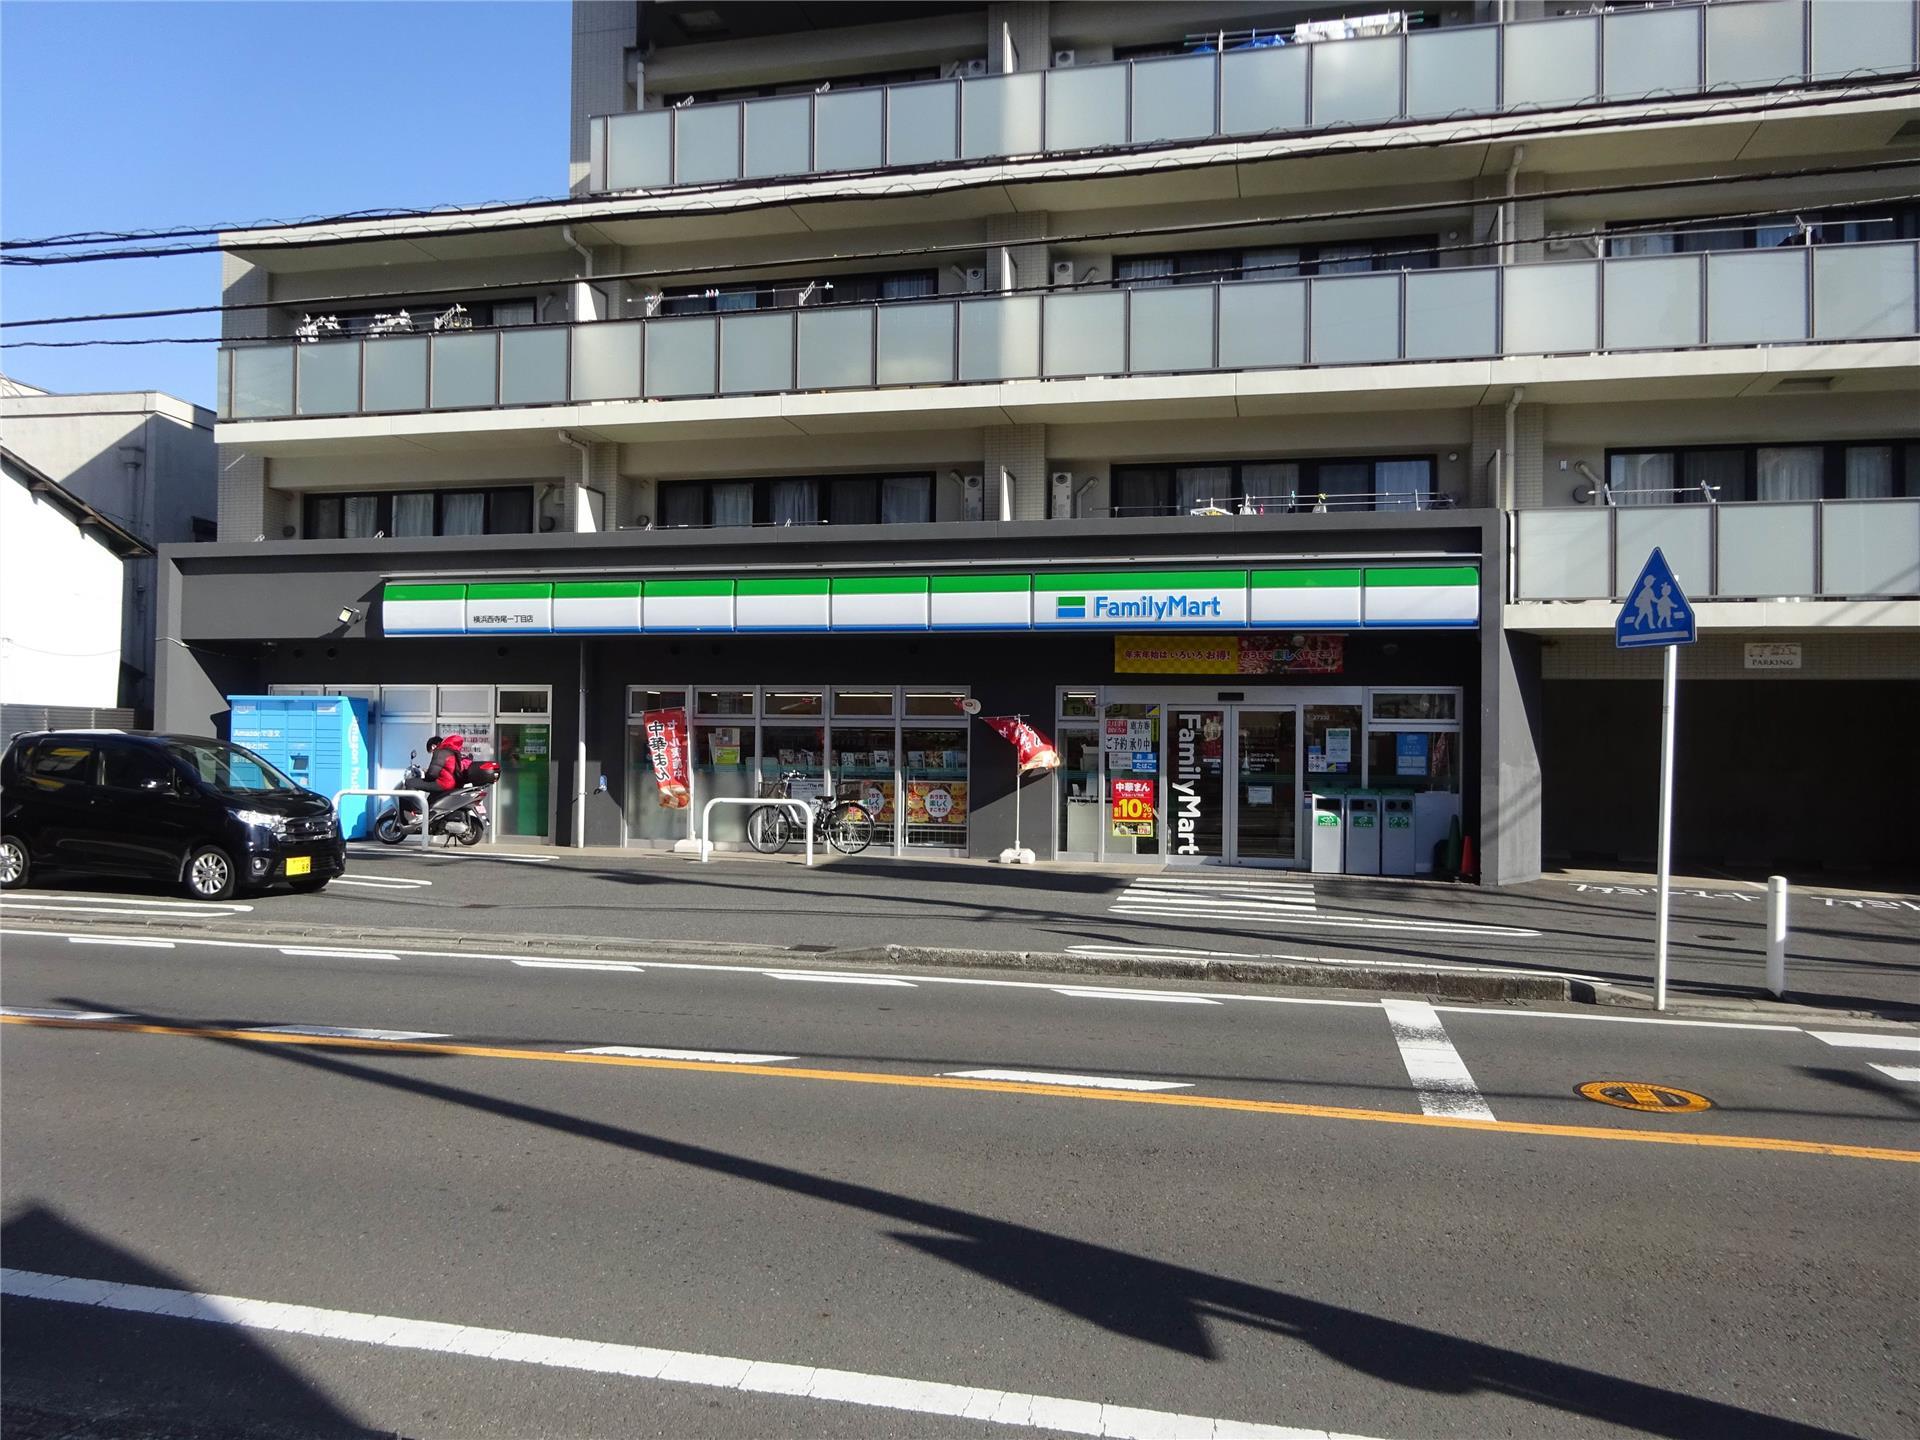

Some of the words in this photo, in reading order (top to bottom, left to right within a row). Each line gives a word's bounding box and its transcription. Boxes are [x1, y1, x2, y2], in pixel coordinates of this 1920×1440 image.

[1095, 595, 1221, 620] FamilyMart
[473, 614, 534, 623] 横浜西寺尾一丁目店
[1106, 736, 1151, 751] ご予約承り中
[1115, 782, 1151, 792] 中華まん
[1172, 714, 1202, 855] FamilyMart
